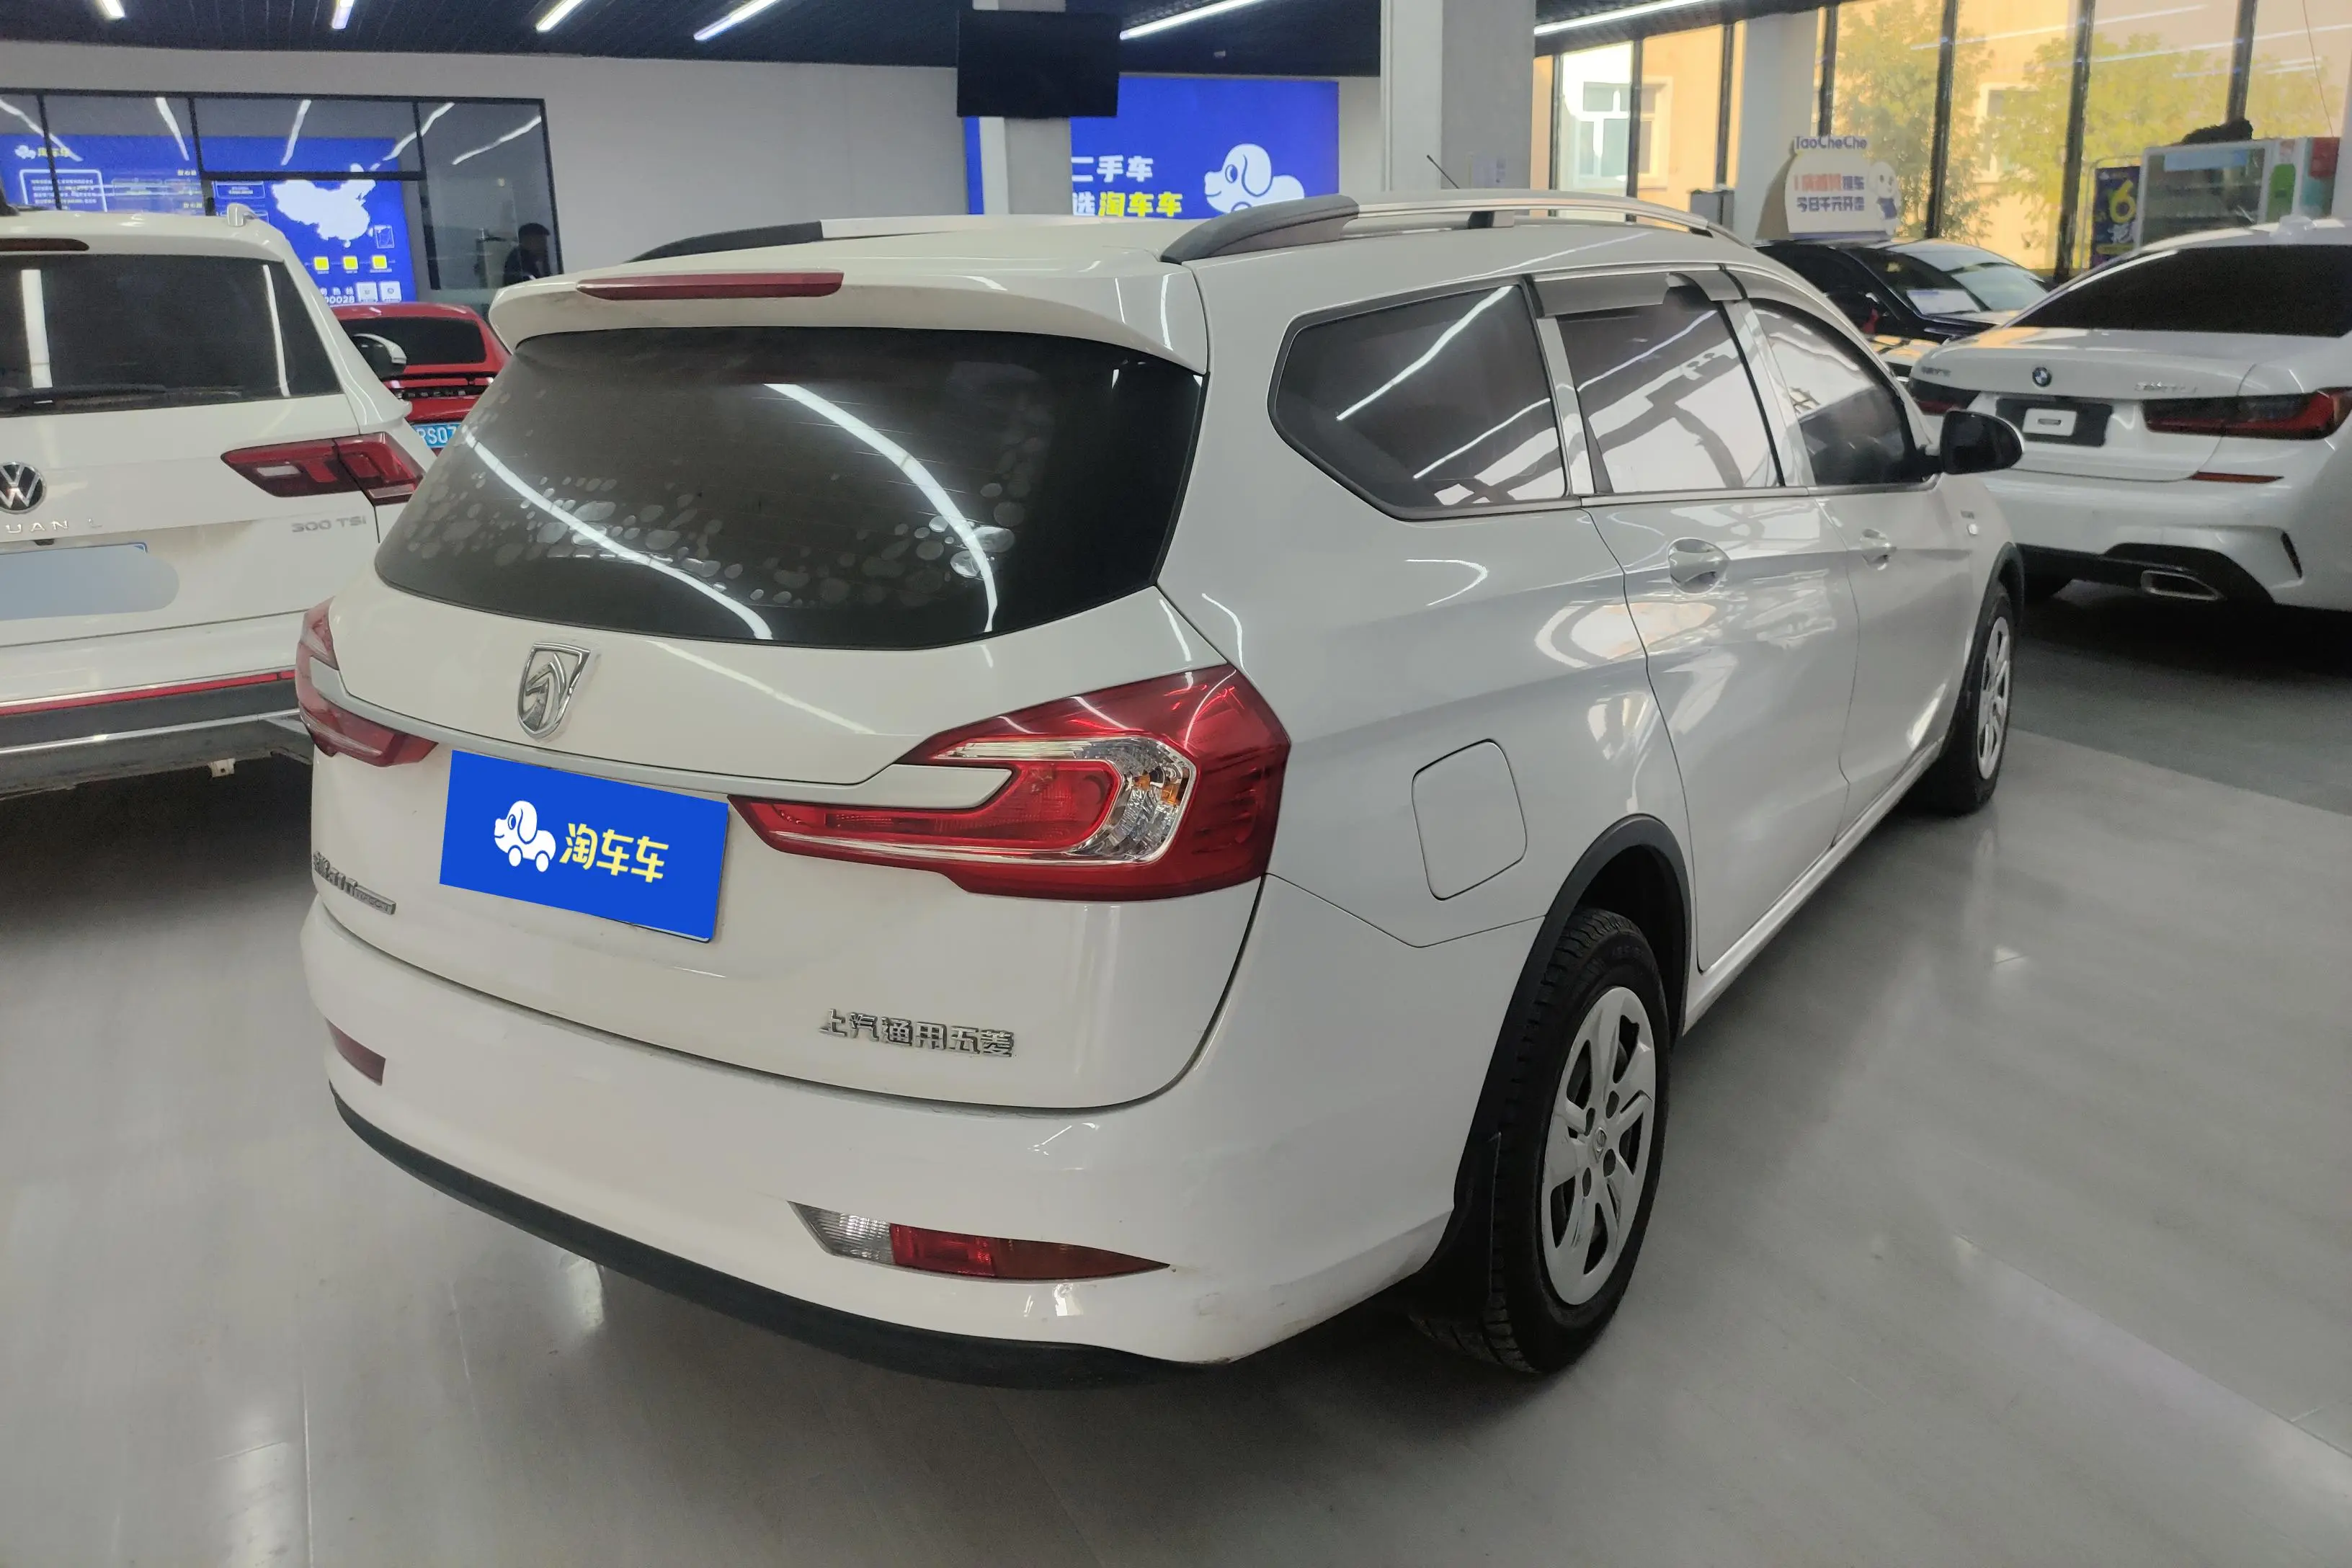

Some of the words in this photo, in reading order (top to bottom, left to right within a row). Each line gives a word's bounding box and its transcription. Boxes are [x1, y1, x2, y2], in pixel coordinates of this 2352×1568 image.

[1795, 135, 1867, 149] TaoCheChe
[1071, 154, 1153, 182] 二手车
[1072, 191, 1183, 217] 选淘车车
[290, 520, 332, 533] 300
[819, 1008, 1014, 1057] 上汽通用五菱
